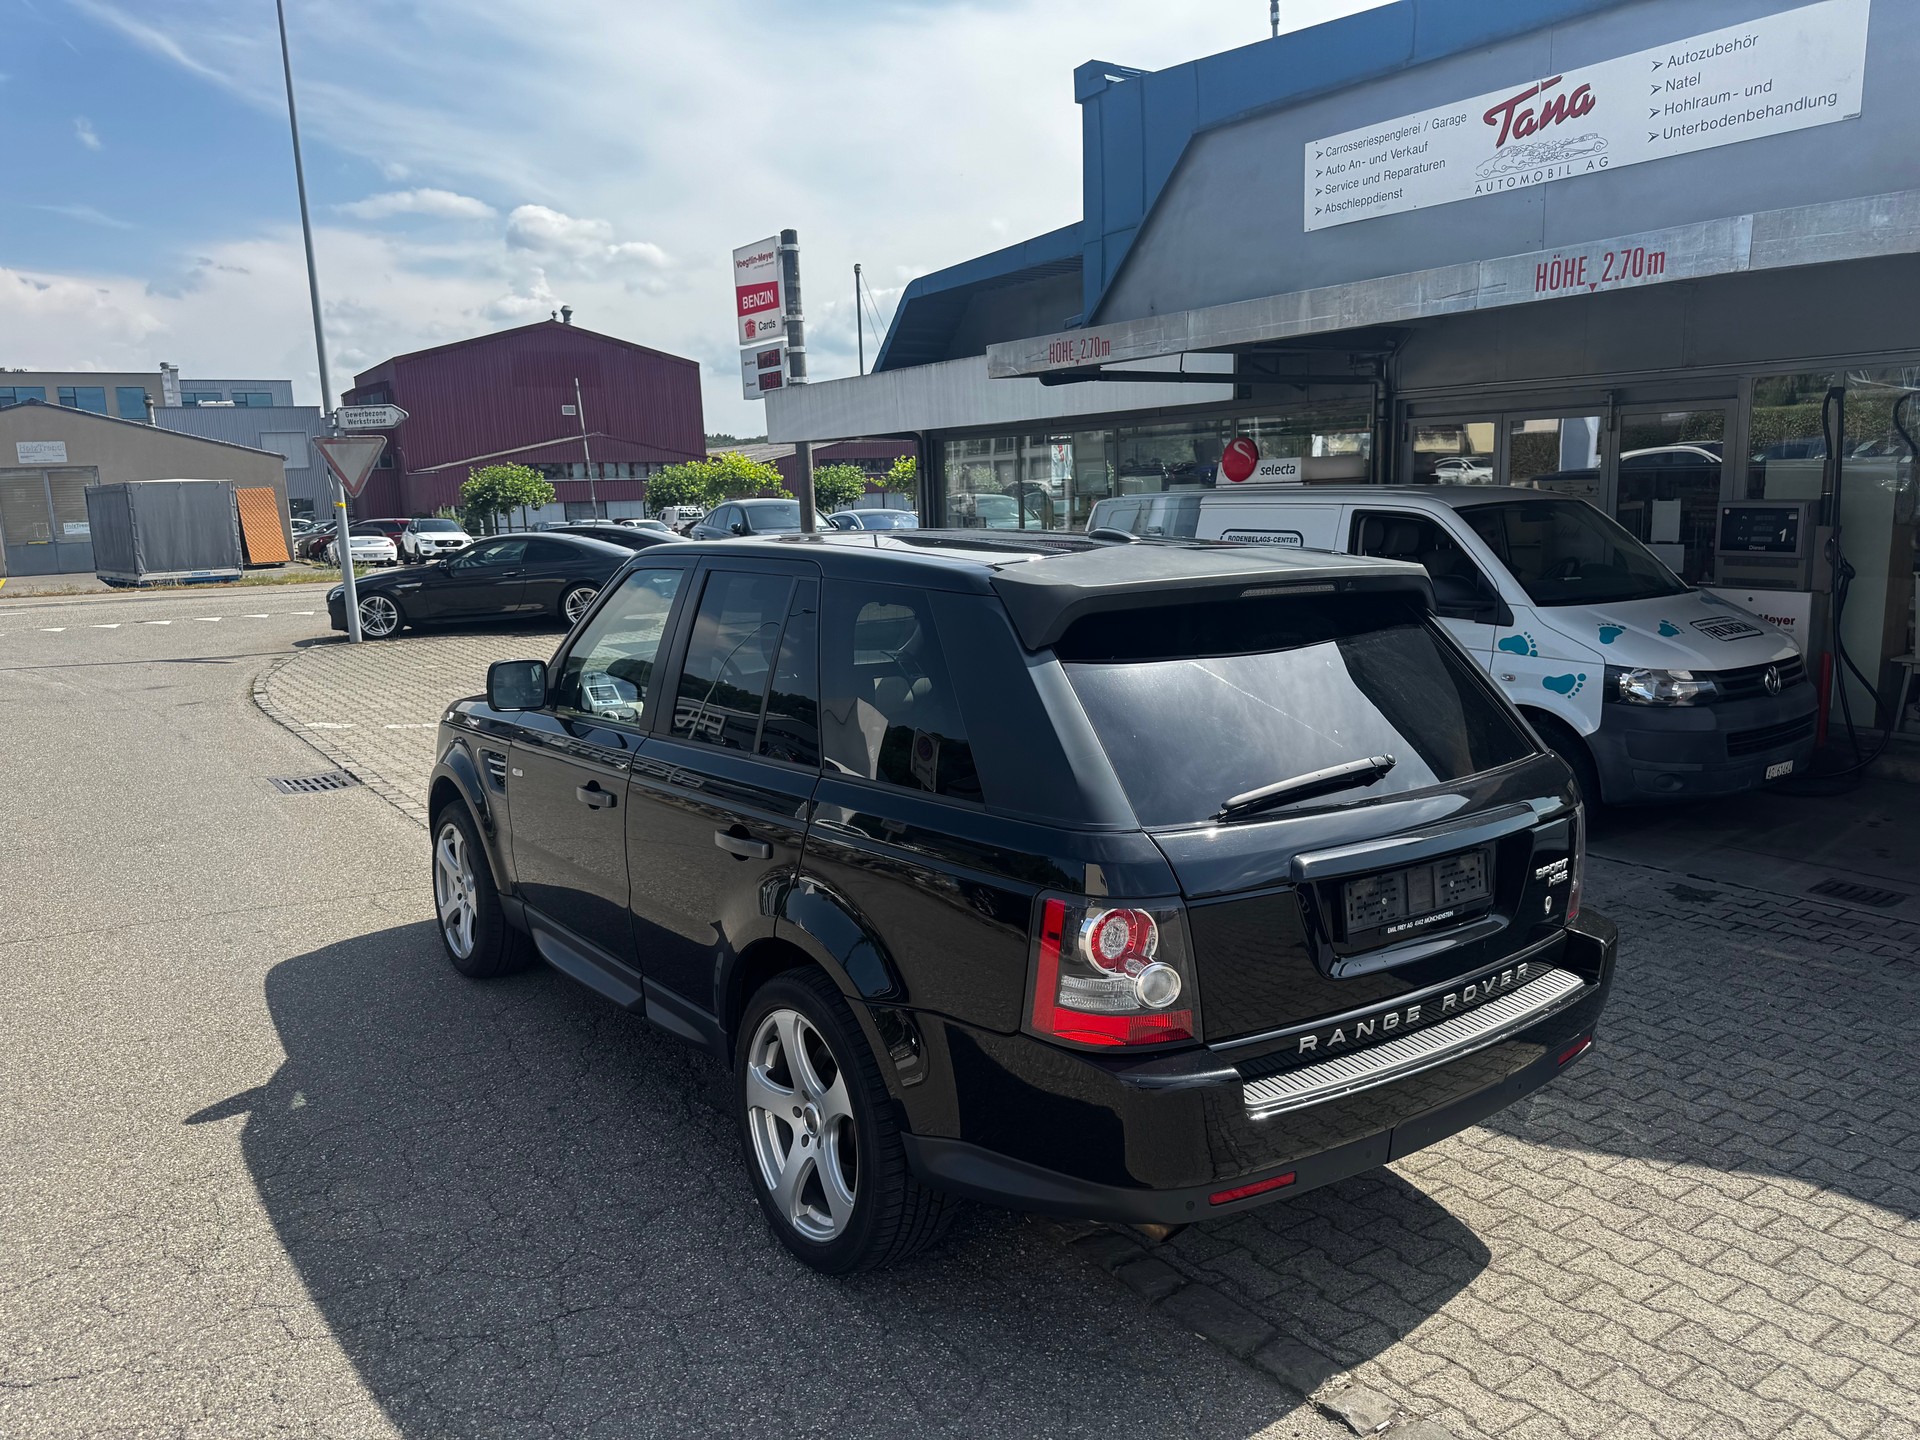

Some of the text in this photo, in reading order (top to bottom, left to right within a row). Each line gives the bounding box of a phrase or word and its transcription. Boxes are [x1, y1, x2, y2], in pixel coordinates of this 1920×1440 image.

[1667, 34, 1759, 69] Autozubehör
[1664, 79, 1773, 116] Hohlraum- und
[1665, 72, 1701, 93] Natel
[1482, 74, 1596, 149] Tana
[1663, 92, 1838, 140] Unterbodenbehandlung
[1325, 123, 1421, 158] Carrosseriespenglerei
[1432, 113, 1467, 130] Garage
[1325, 141, 1429, 176] Auto An- und Verkauf
[1474, 156, 1609, 195] AUTOMOBIL AG
[1325, 159, 1446, 195] Service und Reparaturen
[1325, 188, 1403, 214] Abschleppdienst
[1535, 253, 1588, 292] HÖHE
[742, 289, 774, 310] BENZIN
[758, 319, 776, 331] Cards
[1049, 338, 1074, 364] HÖHE
[1260, 463, 1296, 476] selecta
[1779, 528, 1787, 542] 1
[1536, 857, 1568, 880] SPORT
[1548, 870, 1568, 887] HSE
[1298, 962, 1529, 1054] RANGE ROVER
